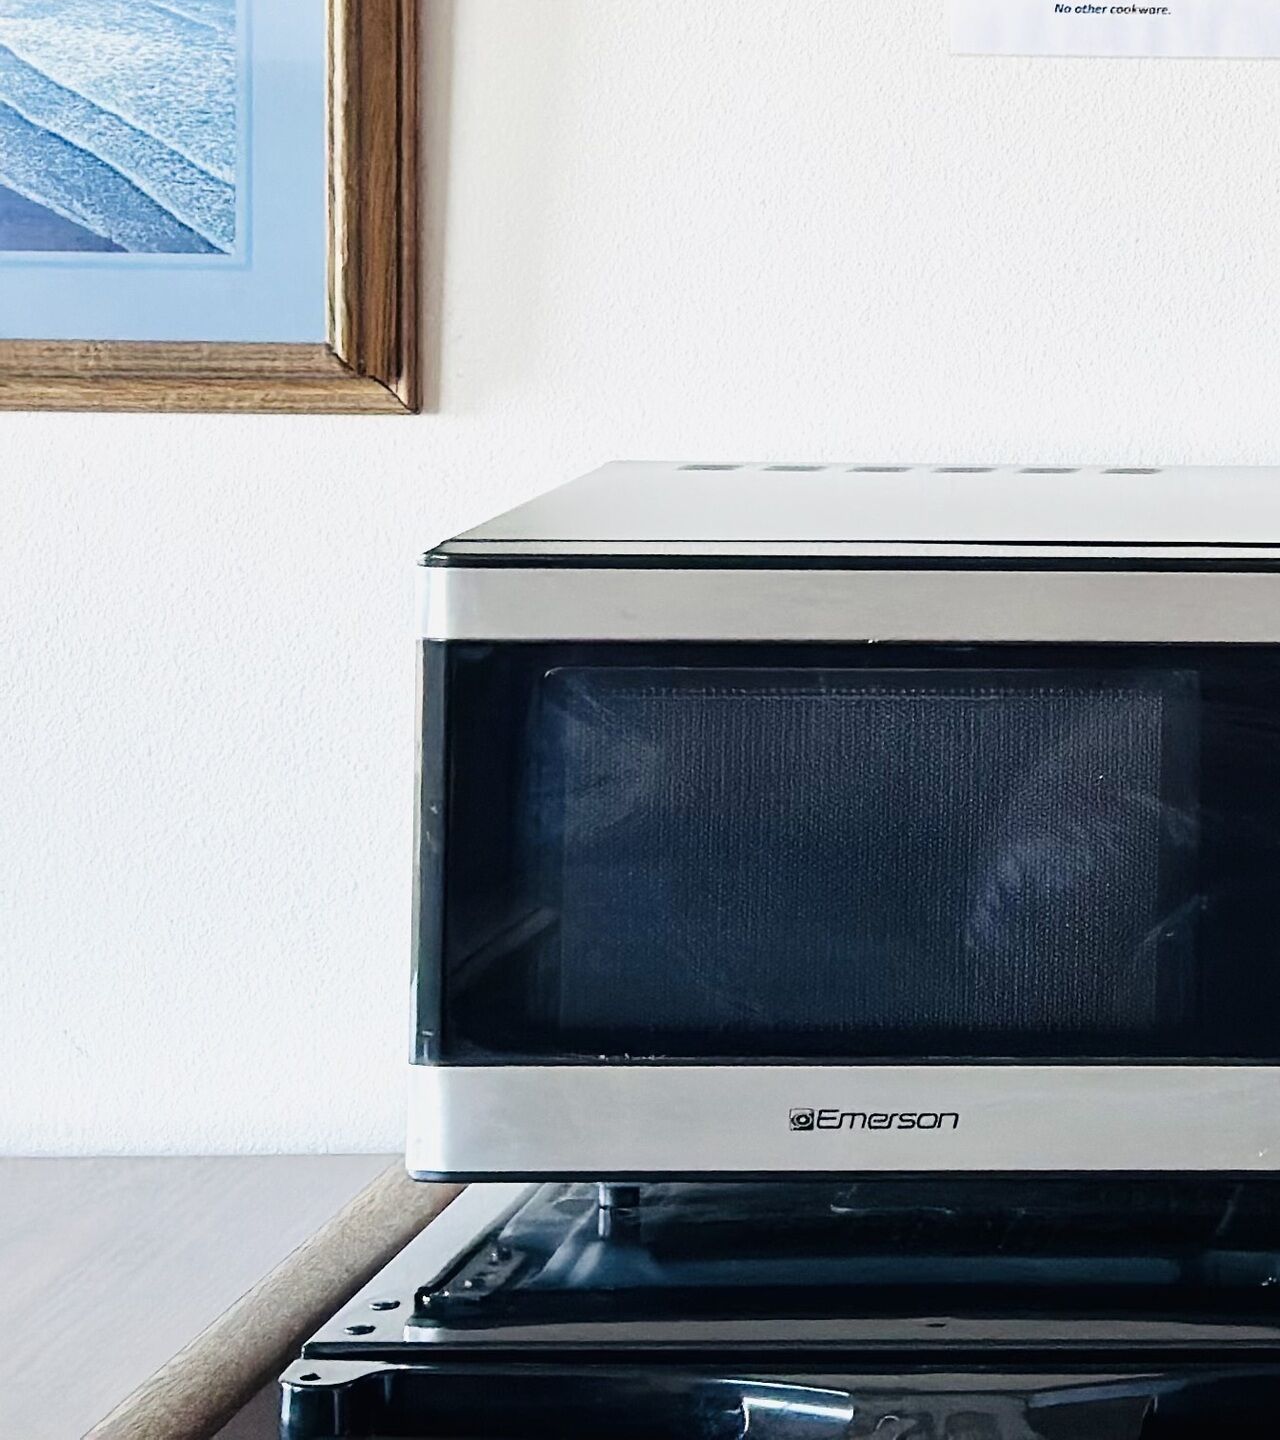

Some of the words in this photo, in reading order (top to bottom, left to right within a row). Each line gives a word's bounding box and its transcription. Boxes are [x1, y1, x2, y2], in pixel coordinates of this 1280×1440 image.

[1054, 3, 1072, 14] No
[1074, 3, 1108, 14] other
[1109, 4, 1171, 15] cookware.
[816, 1109, 959, 1129] Emerson
